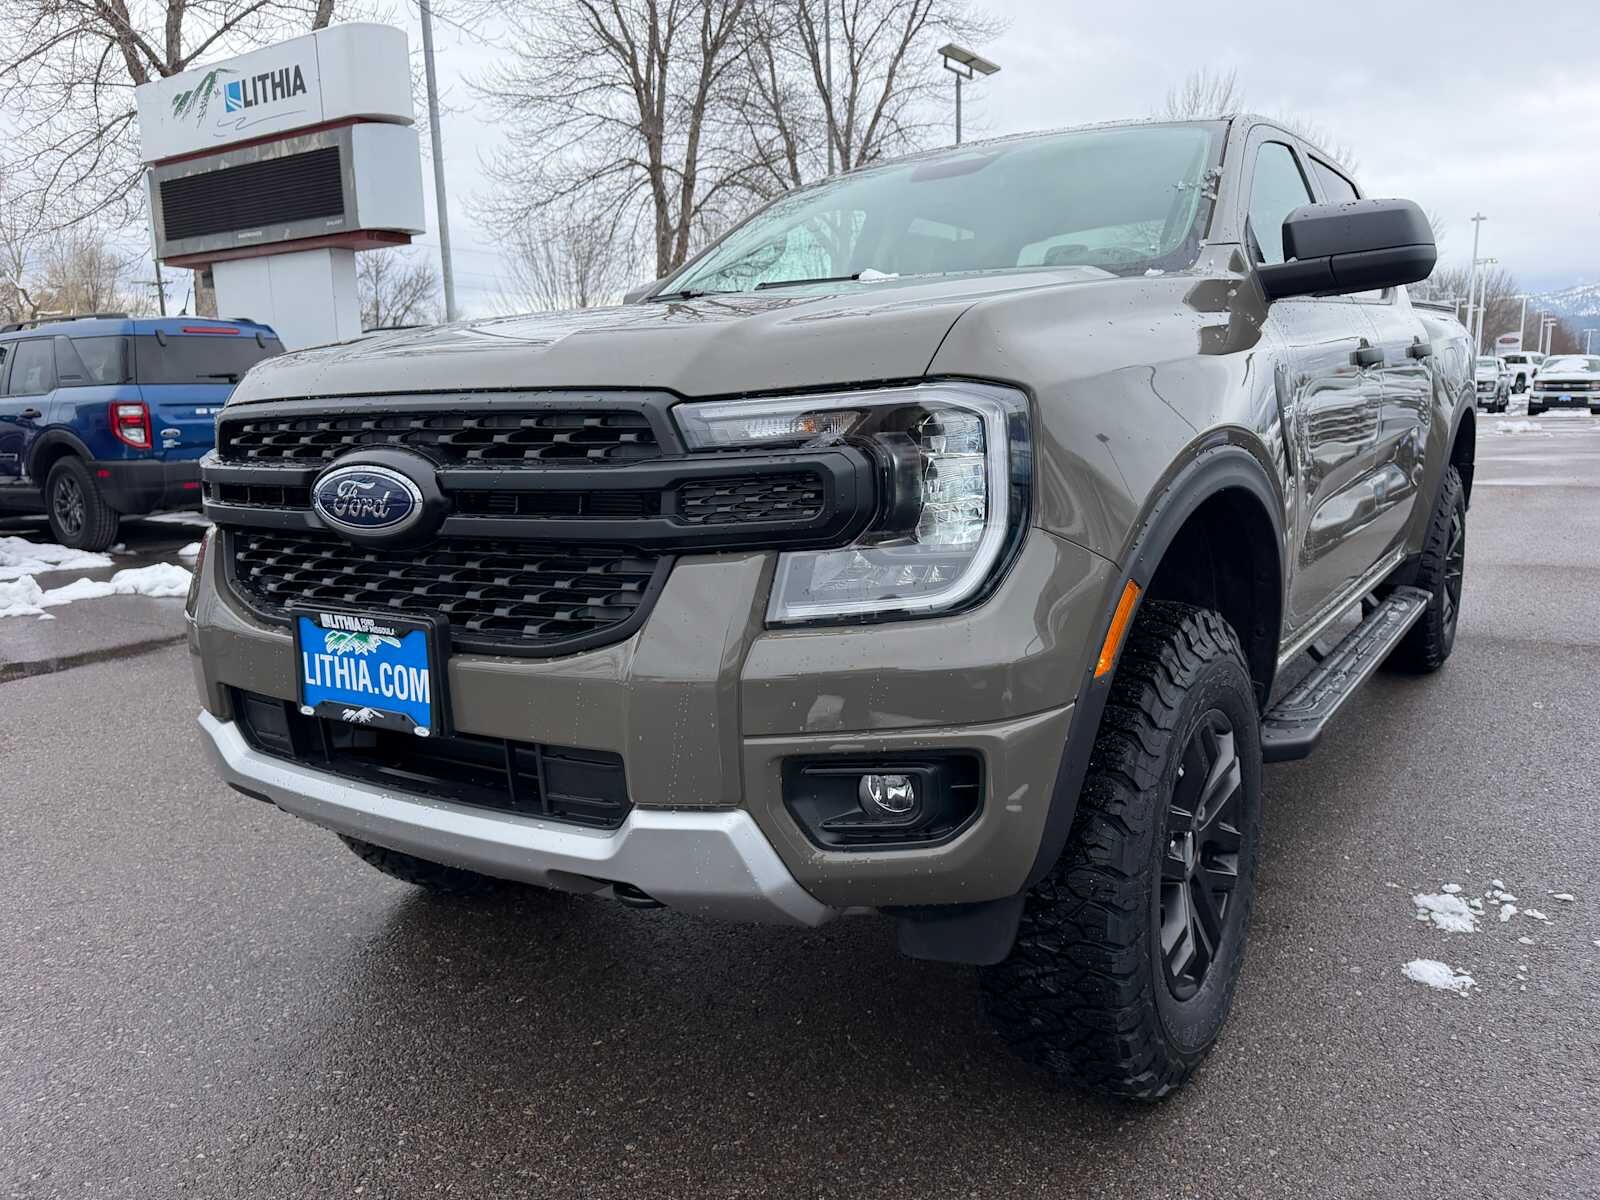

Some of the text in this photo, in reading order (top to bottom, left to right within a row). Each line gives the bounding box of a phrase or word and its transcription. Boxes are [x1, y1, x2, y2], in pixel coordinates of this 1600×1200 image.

[241, 64, 307, 108] LITHIA
[333, 480, 391, 518] Ford
[331, 614, 363, 632] LITHIA
[303, 651, 431, 704] LITHIA.COM
